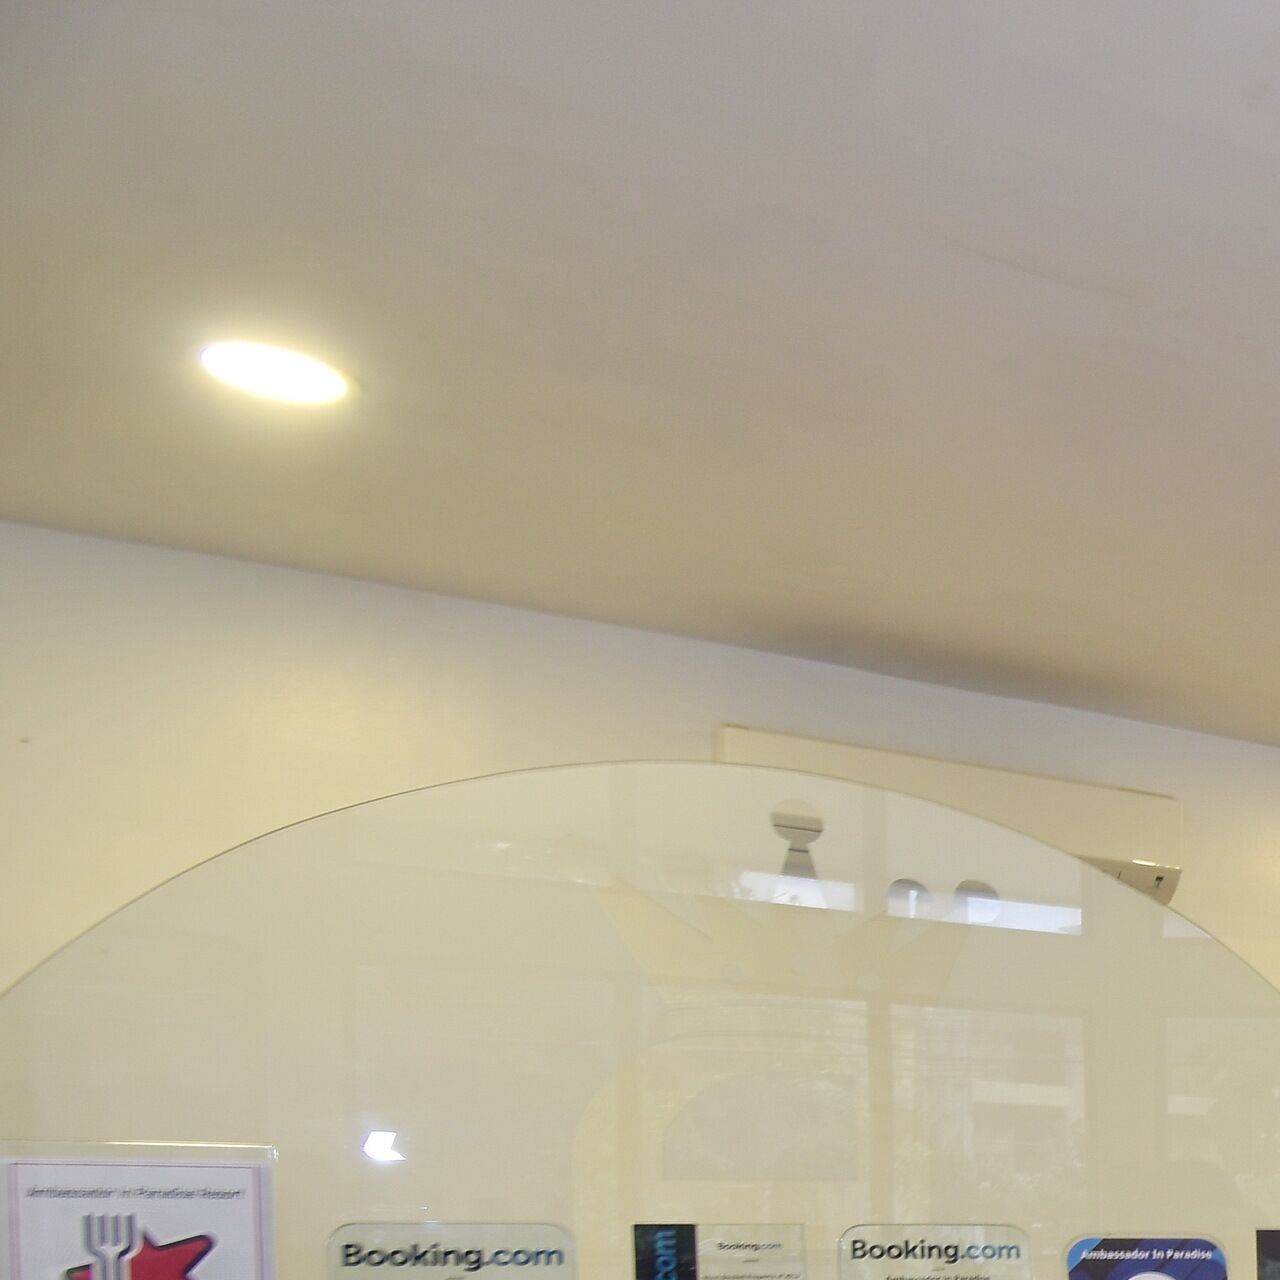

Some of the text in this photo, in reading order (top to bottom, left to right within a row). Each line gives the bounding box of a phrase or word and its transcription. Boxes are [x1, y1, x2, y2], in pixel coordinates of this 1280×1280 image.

[341, 1242, 565, 1272] Booking.com
[850, 1238, 1021, 1264] Booking.com
[1081, 1249, 1149, 1260] Ambassador
[1167, 1249, 1213, 1260] Paradise
